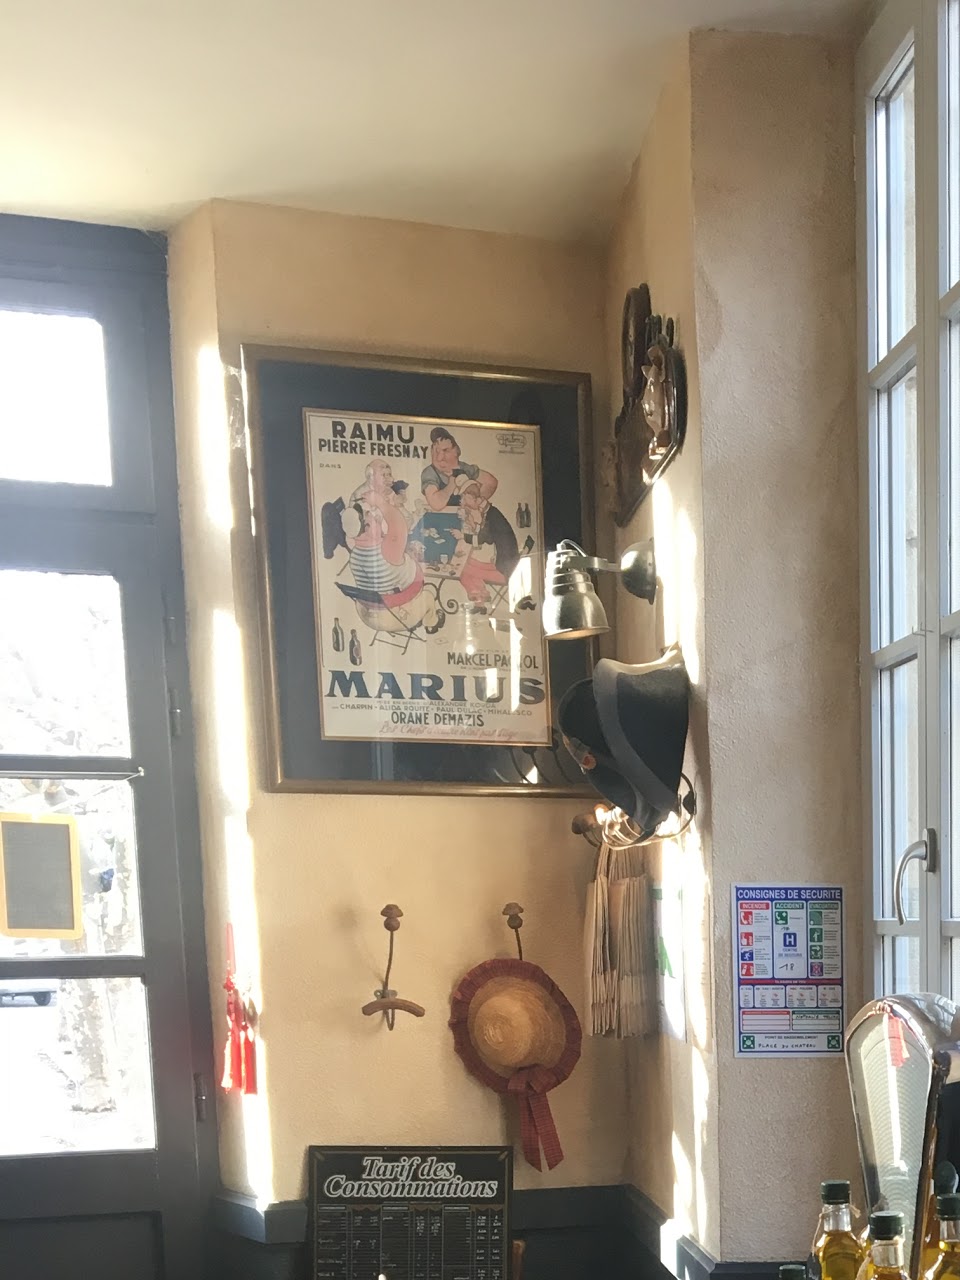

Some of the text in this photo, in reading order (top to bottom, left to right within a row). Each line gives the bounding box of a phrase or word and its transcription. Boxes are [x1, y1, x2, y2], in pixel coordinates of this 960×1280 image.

[331, 420, 415, 444] RAIMU
[318, 438, 429, 459] PIERRE FRESNAY
[447, 651, 539, 669] MARCEL PAOL
[324, 669, 546, 705] MARIUS
[339, 703, 373, 711] CHARPIN
[429, 700, 467, 708] ALEXANDRE
[391, 711, 485, 727] ORANE DEMAZIS
[737, 889, 841, 899] CONSIGNES DE SECURITE
[361, 1156, 456, 1182] Tarif des
[324, 1174, 498, 1198] Consommations
